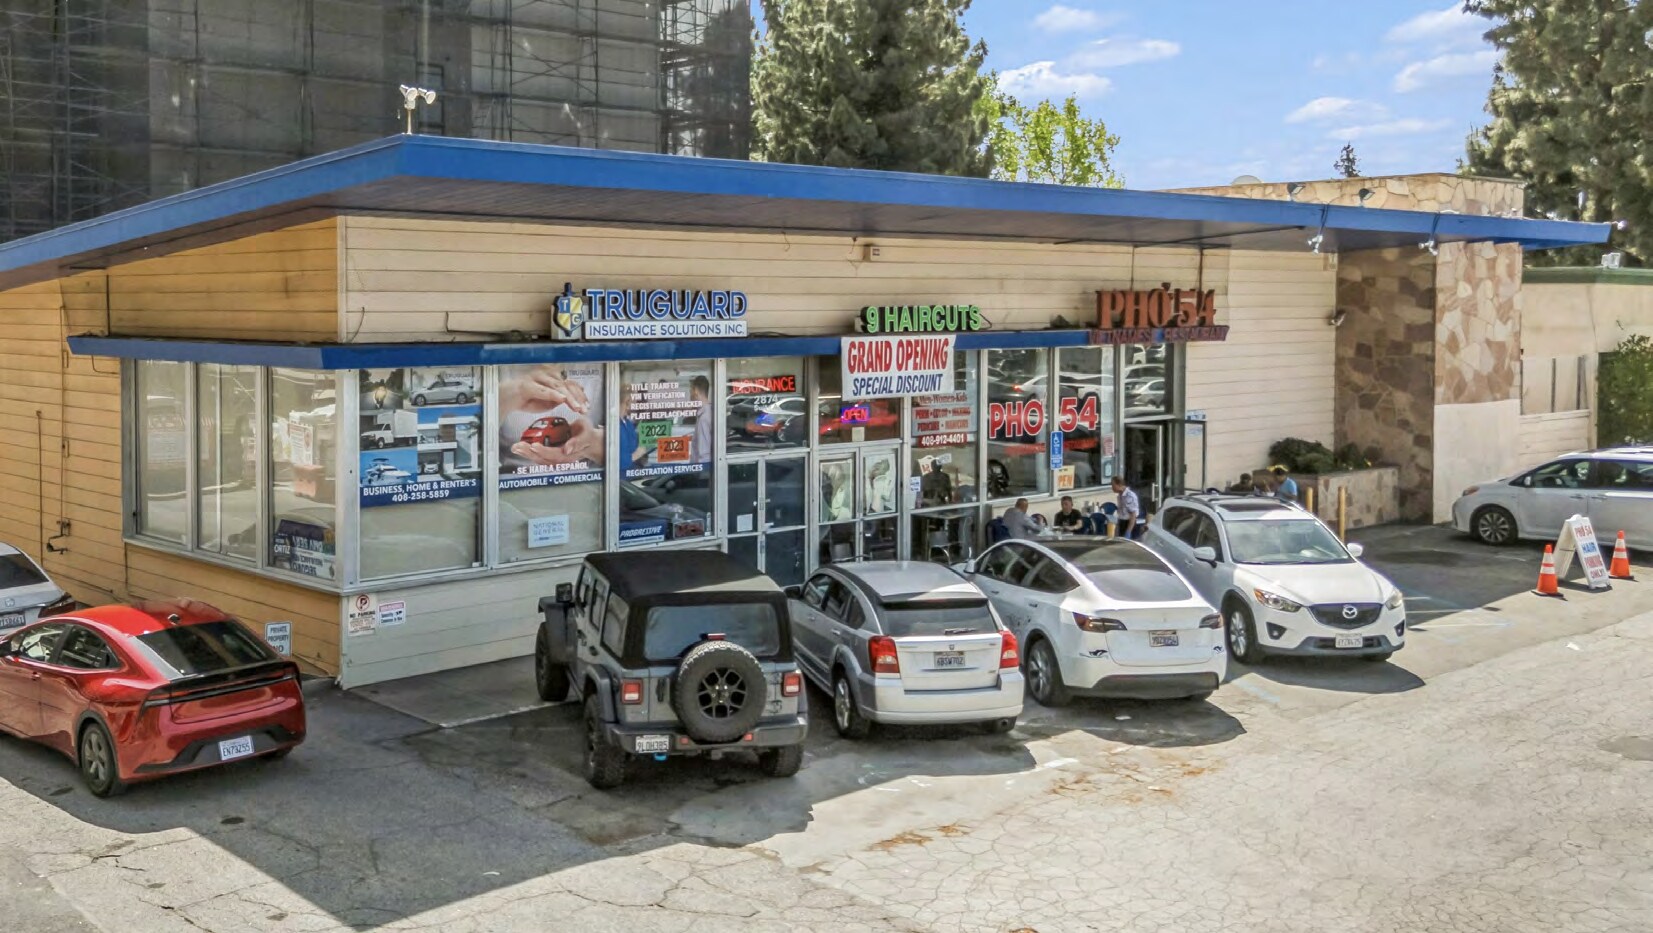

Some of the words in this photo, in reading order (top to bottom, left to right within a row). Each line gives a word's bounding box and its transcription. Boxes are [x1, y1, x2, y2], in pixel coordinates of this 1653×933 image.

[561, 300, 568, 311] T
[585, 288, 748, 320] TRUGUARD
[1174, 288, 1217, 328] 54
[866, 306, 879, 333] 9
[884, 305, 982, 332] HAIRCUTS
[589, 325, 657, 336] INSURANCE
[660, 323, 722, 336] SOLUTIONS
[724, 323, 745, 335] INC.
[847, 340, 893, 374] GRAND
[896, 337, 949, 372] OPENING
[630, 383, 649, 392] TITLE
[732, 376, 796, 394] INSURANCE
[852, 378, 894, 397] SPECIAL
[896, 373, 943, 394] DISCOUNT
[630, 393, 642, 401] VIN
[643, 391, 686, 400] VERIFICATION
[630, 402, 676, 411] REGISTRATION
[676, 400, 703, 409] STICKER
[630, 412, 651, 420] PLATE
[652, 409, 697, 419] REPLACEMENT
[843, 407, 869, 421] OPEN
[988, 399, 1045, 438] PHO
[1058, 396, 1099, 432] 54
[645, 424, 667, 437] 2022
[663, 440, 684, 452] 2023
[517, 464, 527, 475] SE
[529, 463, 553, 474] HABLA
[555, 460, 589, 472] ESPAÑOL
[626, 465, 673, 477] REGISTRATION
[674, 464, 703, 474] SERVICES
[363, 486, 405, 496] BUSINESS,
[406, 483, 431, 493] HOME
[432, 481, 439, 490] &
[440, 479, 477, 489] RENTER'S
[499, 478, 548, 489] AUTOMOBILE
[553, 473, 602, 484] COMMERCIAL
[391, 489, 450, 502] 408-258-5859
[620, 526, 663, 538] PROGRESSIVE
[274, 544, 291, 555] ORTIZ
